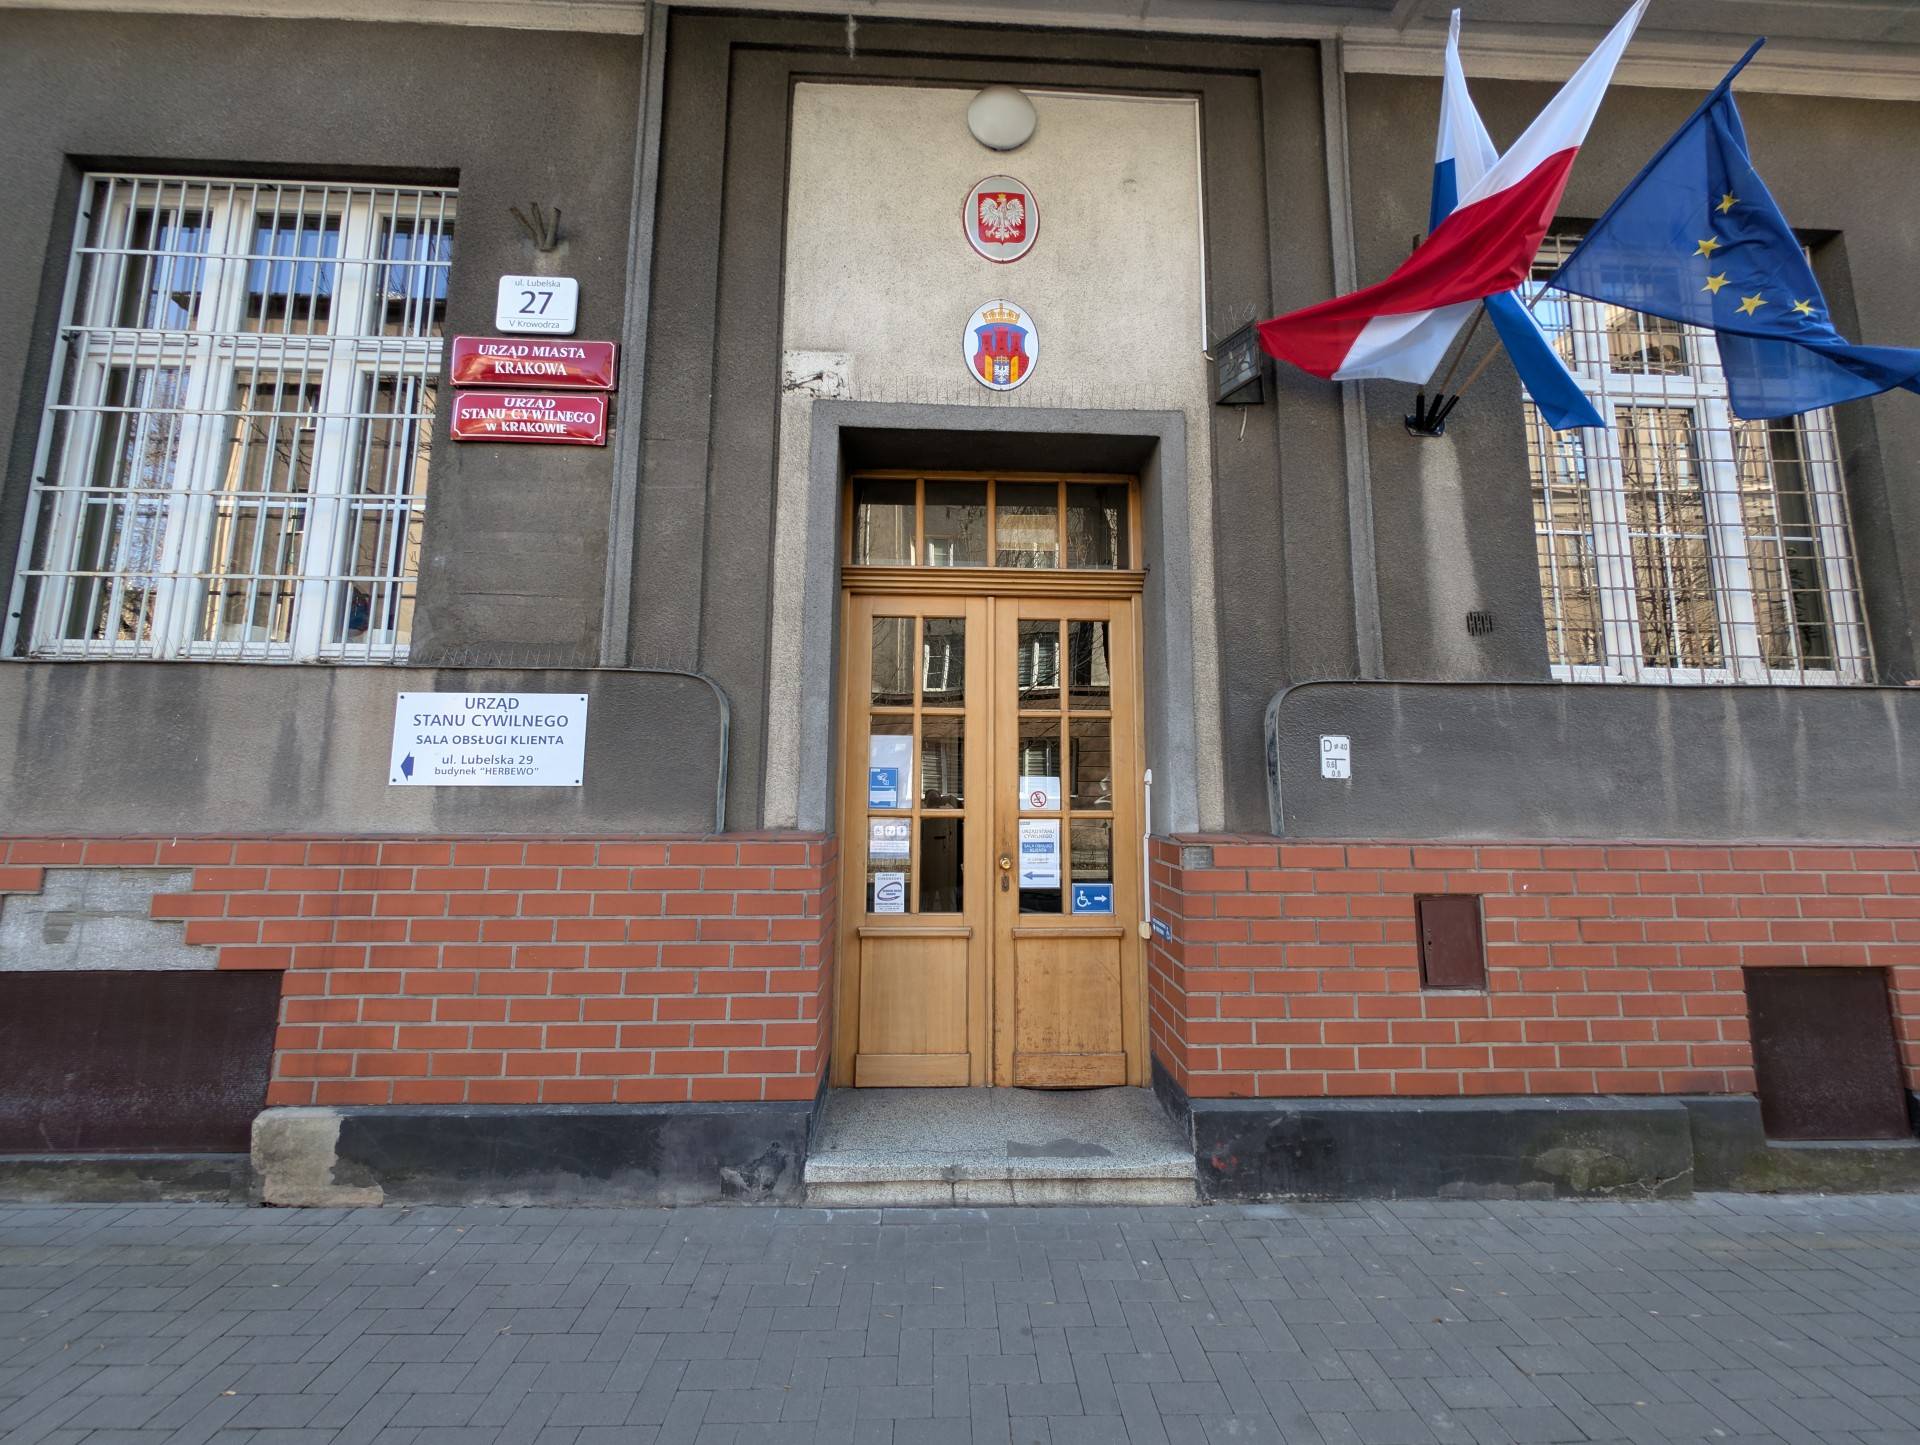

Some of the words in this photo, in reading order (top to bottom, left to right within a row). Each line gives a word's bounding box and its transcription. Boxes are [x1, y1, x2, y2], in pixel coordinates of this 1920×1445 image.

[515, 279, 525, 288] ul.
[527, 279, 561, 288] Lubelska
[519, 291, 554, 315] 27
[517, 320, 560, 329] Krowodrza
[478, 344, 529, 359] URZĄD
[531, 346, 586, 359] MIASTA
[494, 361, 568, 376] KRAKOWA
[504, 397, 556, 409] URZĄD
[461, 408, 506, 420] STANU
[511, 409, 596, 424] CYWILNEGO
[501, 422, 568, 434] KRAKOWIE
[465, 697, 519, 713] URZĄD
[413, 714, 466, 727] STANU
[471, 714, 569, 728] CYWILNEGO
[416, 735, 449, 745] SALA
[452, 735, 507, 746] OBSŁUGI
[510, 735, 564, 745] KLIENTA
[1323, 740, 1332, 752] D
[441, 755, 456, 765] ul.
[461, 755, 514, 765] Lubelska
[518, 755, 534, 765] 29
[434, 767, 476, 777] budynek
